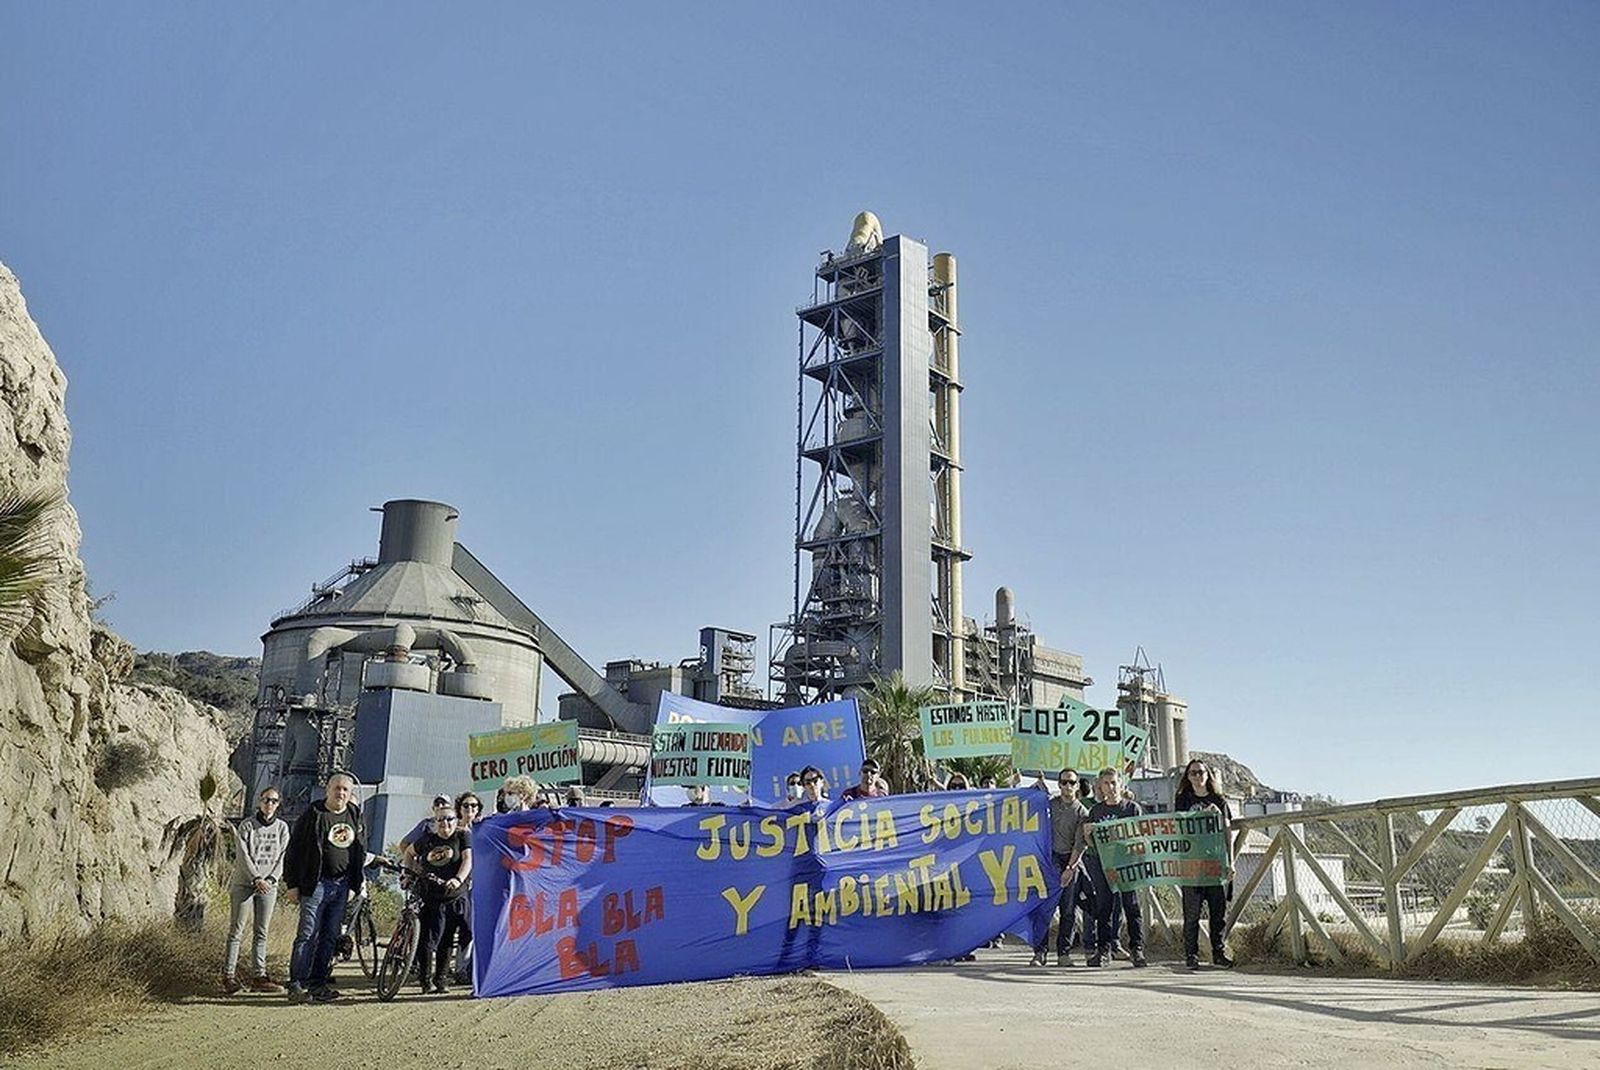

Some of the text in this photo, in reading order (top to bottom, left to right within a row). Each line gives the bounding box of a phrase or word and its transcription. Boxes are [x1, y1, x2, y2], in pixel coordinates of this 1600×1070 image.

[930, 704, 1007, 725] ESTAMOS HASTA
[1082, 710, 1121, 742] 26
[782, 718, 847, 747] AIRE
[932, 729, 954, 747] LOS
[470, 758, 508, 782] CERO
[651, 757, 697, 778] NUESTRO
[503, 814, 635, 872] STOP
[696, 794, 1041, 862] JUSTICIA SOCIAL
[1150, 840, 1192, 853] AVOID
[721, 844, 1049, 936] Y AMBIENTAL YA
[508, 885, 665, 941] BLA BLA
[554, 936, 640, 979] BLA
